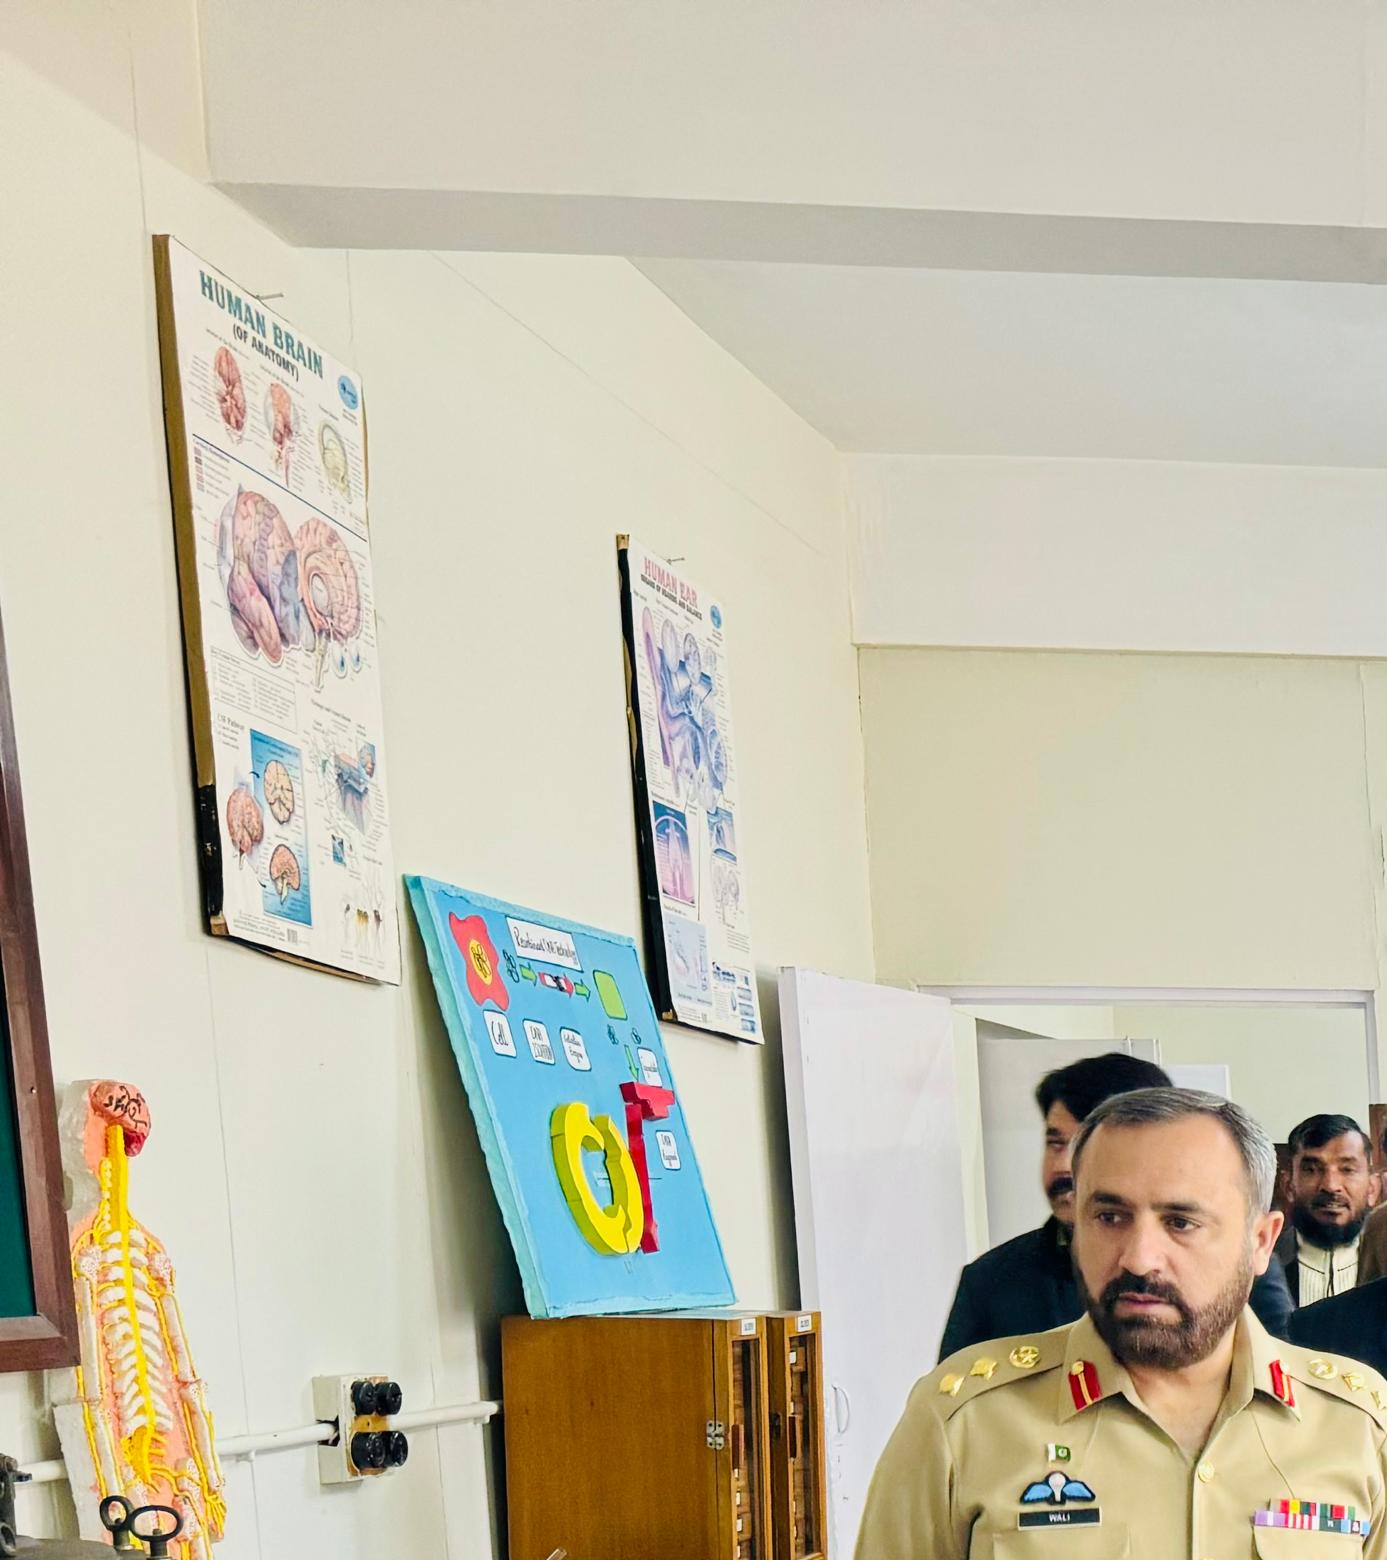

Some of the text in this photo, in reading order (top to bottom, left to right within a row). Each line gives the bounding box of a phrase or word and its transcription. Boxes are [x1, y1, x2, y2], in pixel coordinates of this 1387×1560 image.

[199, 270, 323, 380] HUMAN BRAIN
[251, 336, 299, 383] ANATOMY)
[644, 556, 699, 609] HUMAN EAR
[1048, 1513, 1071, 1523] WALI
